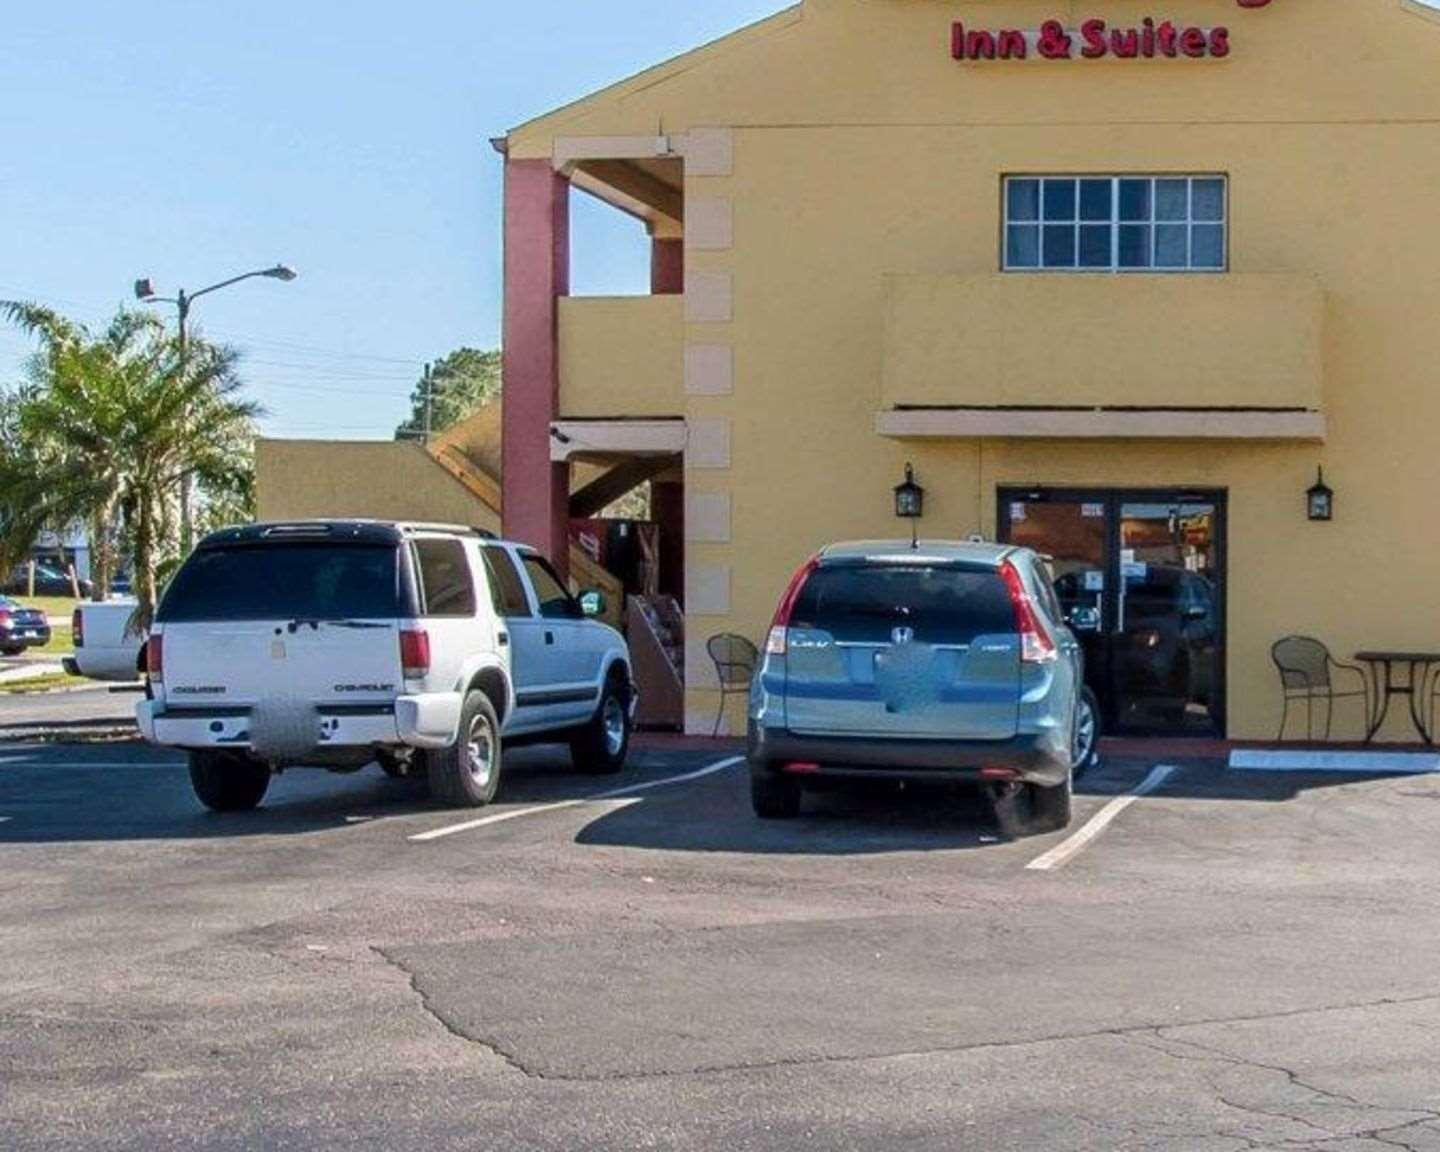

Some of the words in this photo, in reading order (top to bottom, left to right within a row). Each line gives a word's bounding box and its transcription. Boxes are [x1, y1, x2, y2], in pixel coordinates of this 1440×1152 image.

[951, 20, 1026, 59] Inn
[1037, 19, 1071, 59] &
[1080, 16, 1230, 58] Suites
